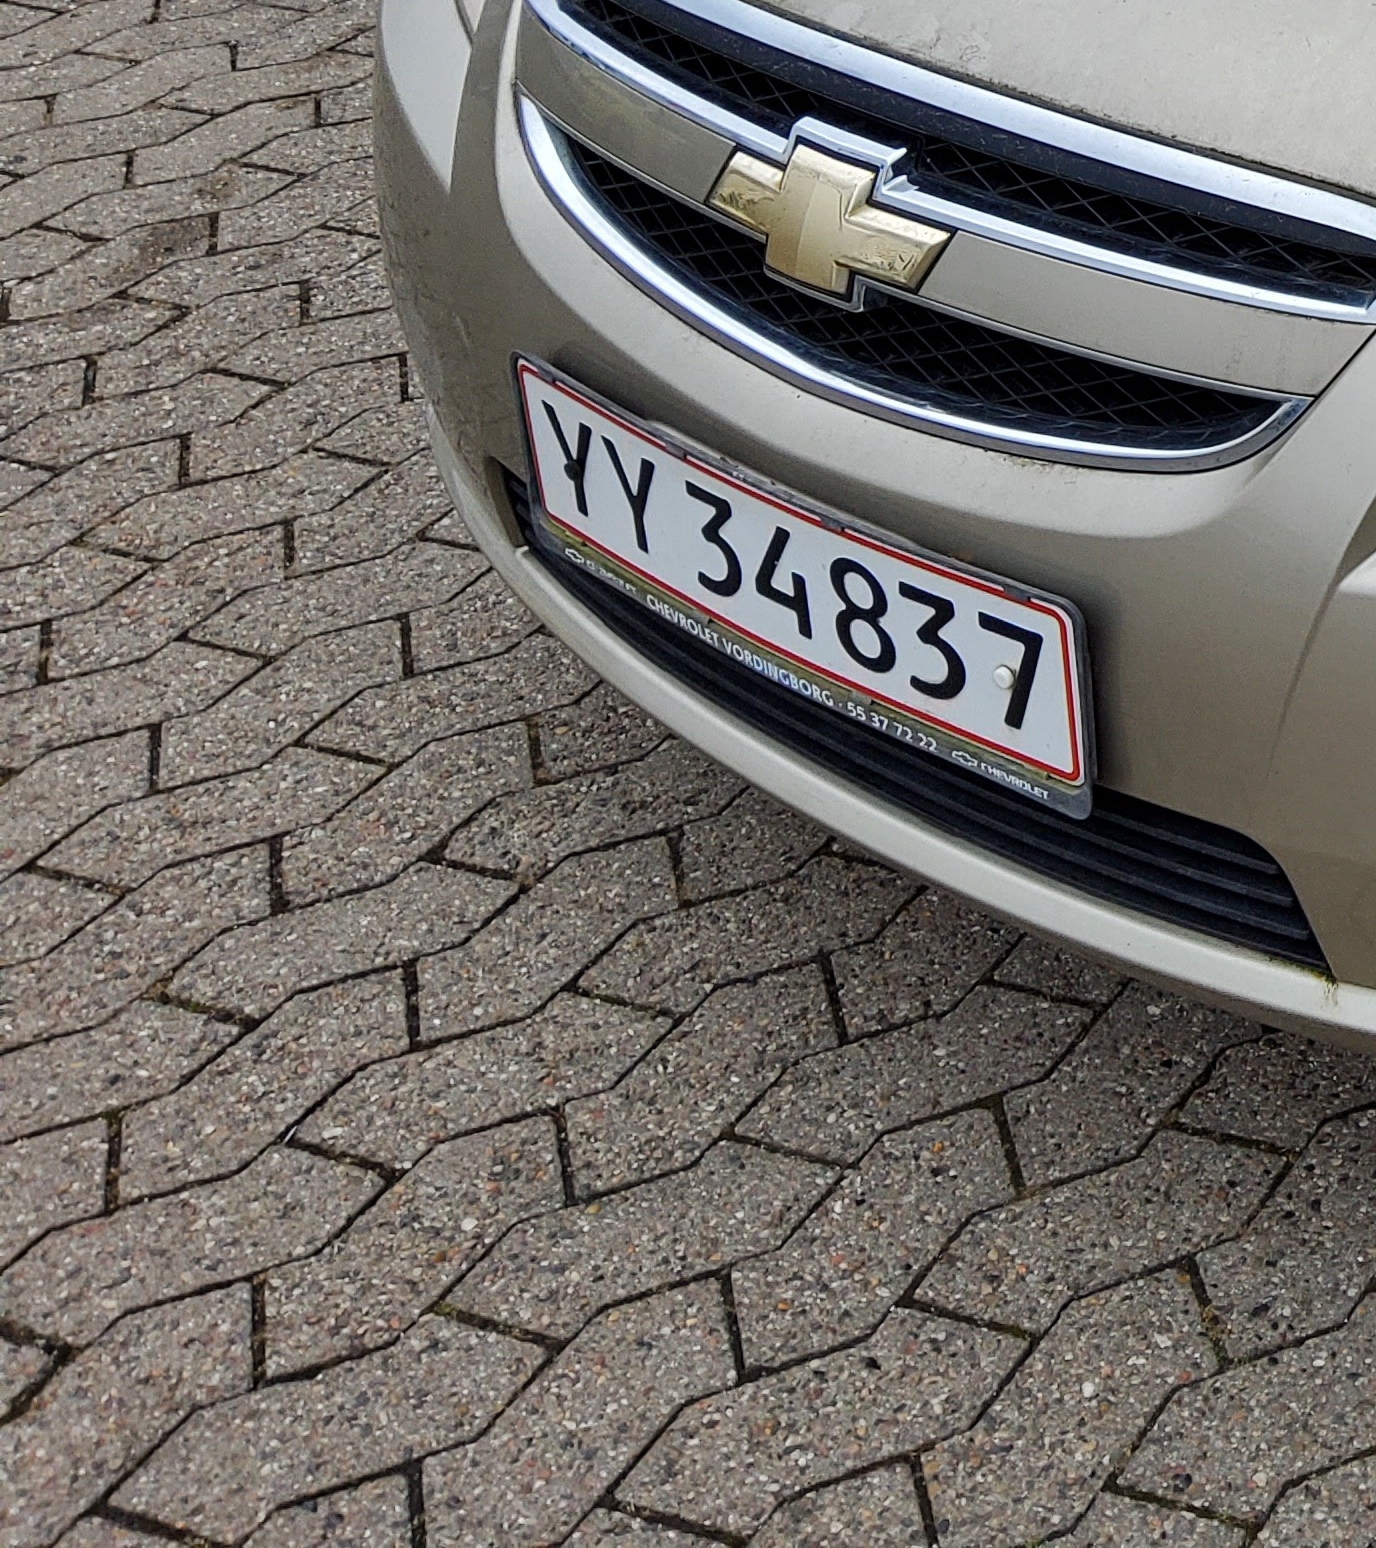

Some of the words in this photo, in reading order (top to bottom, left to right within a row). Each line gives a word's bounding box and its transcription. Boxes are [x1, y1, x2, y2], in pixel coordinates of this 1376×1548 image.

[646, 594, 720, 648] CHEVROLET
[722, 640, 834, 707] VORDINGBORG
[847, 702, 867, 721] 55
[870, 711, 889, 731] 37
[893, 722, 914, 743] 72
[917, 733, 938, 752] 22
